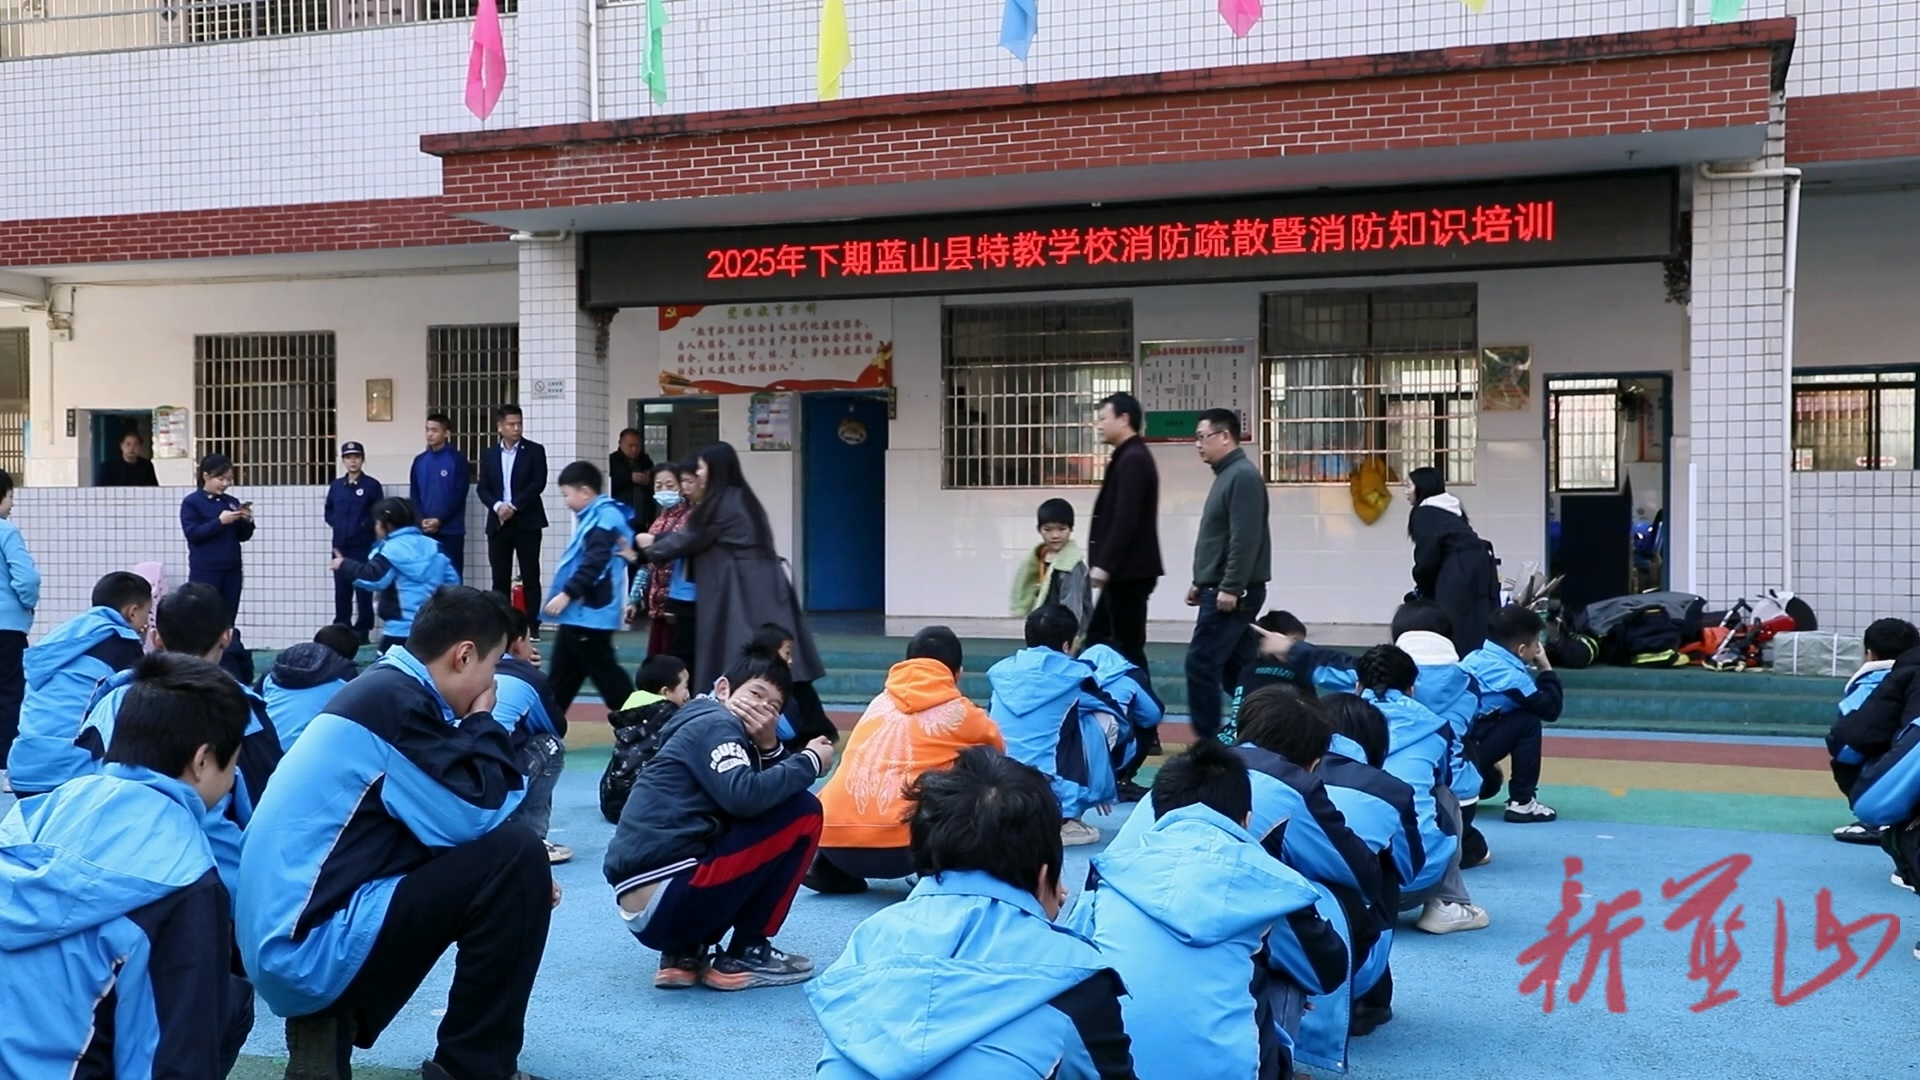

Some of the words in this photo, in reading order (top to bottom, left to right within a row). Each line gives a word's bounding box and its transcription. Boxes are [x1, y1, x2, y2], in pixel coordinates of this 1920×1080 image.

[707, 201, 1553, 278] 2025年下期蓝山县特教学校消防疏散暨消防知识培训
[727, 302, 818, 320] 党的教育方针
